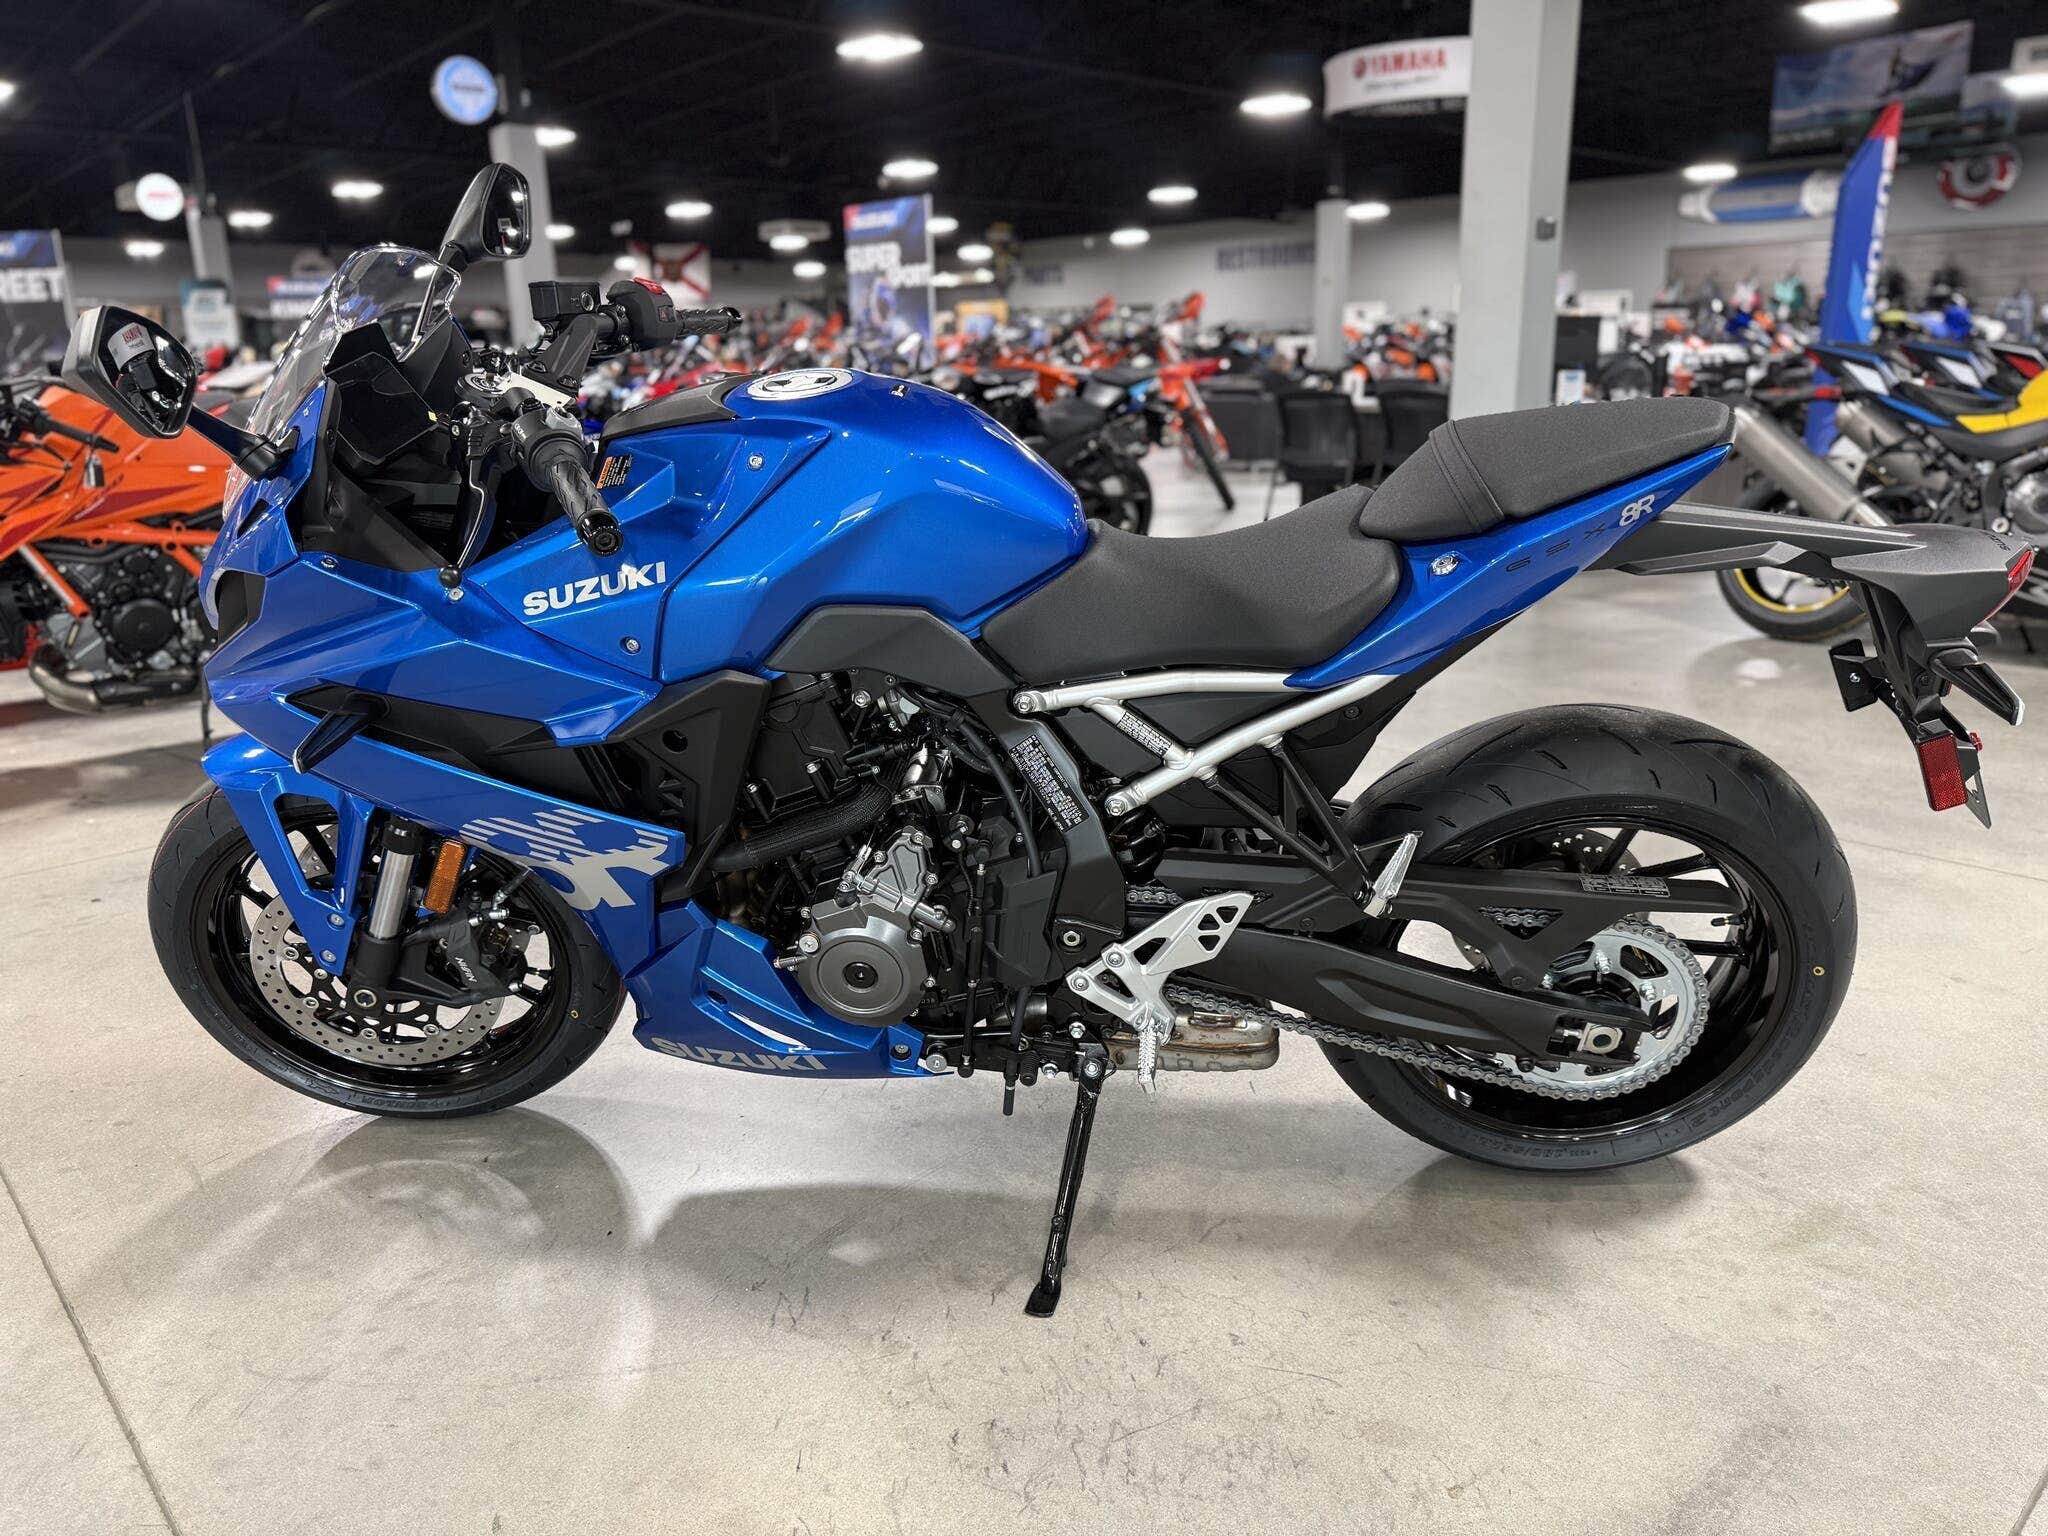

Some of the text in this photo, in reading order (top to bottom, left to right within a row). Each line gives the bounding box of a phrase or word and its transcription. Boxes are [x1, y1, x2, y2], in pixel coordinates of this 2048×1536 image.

[1619, 494, 1655, 527] 8R
[522, 561, 667, 616] SUZUKI
[651, 1037, 828, 1070] SUZUKI
